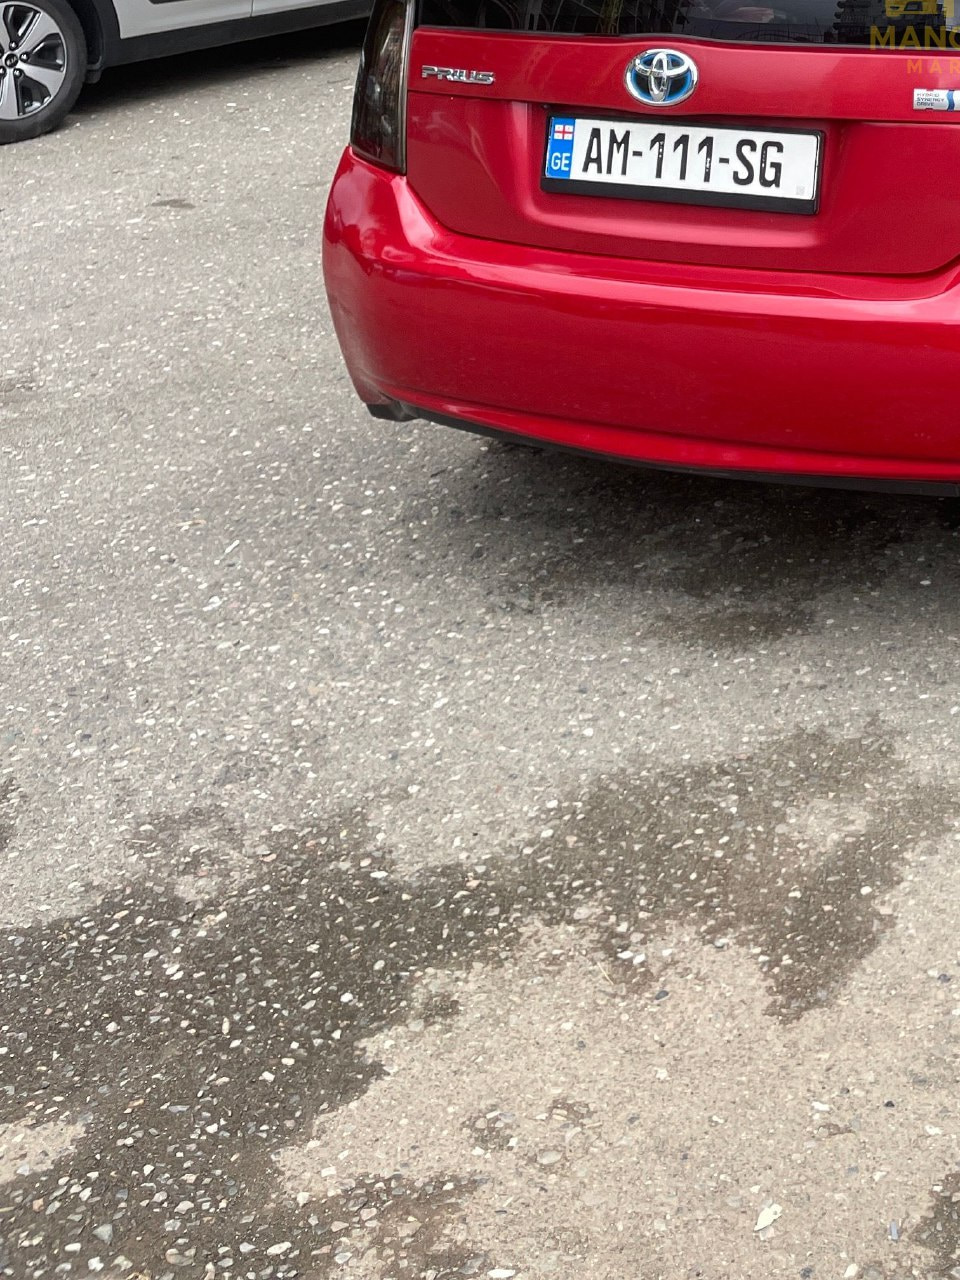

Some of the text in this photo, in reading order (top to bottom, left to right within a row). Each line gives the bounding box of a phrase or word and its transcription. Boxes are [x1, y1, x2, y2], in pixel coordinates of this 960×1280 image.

[422, 65, 495, 84] PRIUS
[551, 152, 571, 171] GE
[581, 127, 784, 188] AM-111-SG
